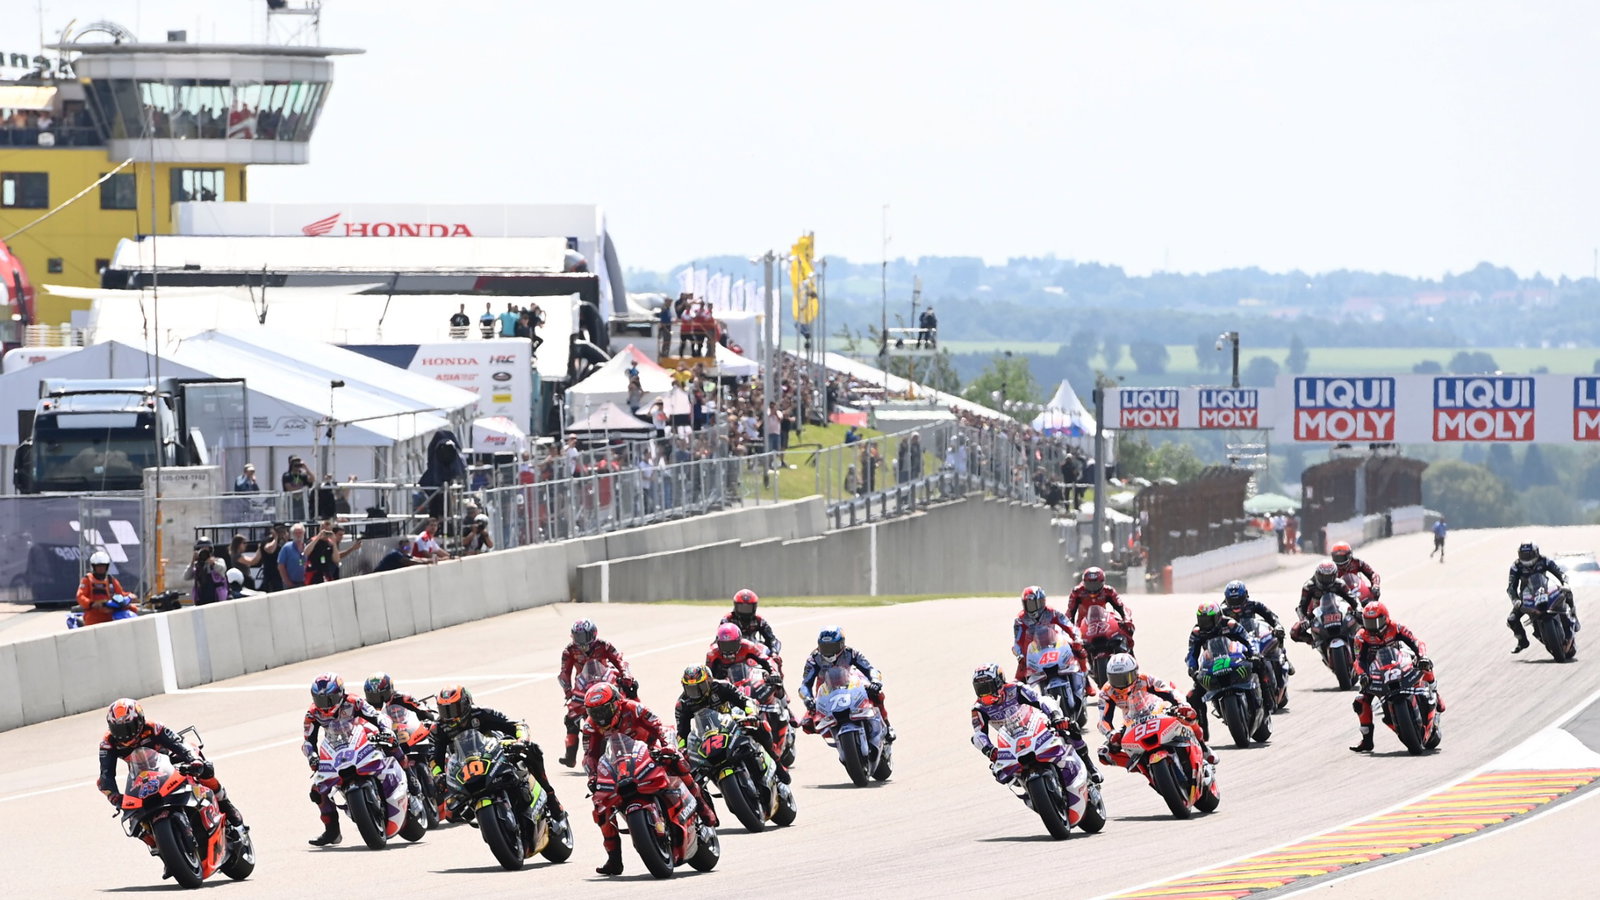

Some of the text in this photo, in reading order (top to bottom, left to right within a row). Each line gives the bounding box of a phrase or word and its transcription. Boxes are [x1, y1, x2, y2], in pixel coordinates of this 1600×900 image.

[343, 222, 473, 237] HONDA
[422, 358, 479, 366] HONDA
[489, 355, 516, 364] HRC
[1123, 391, 1177, 408] LIQUI
[1201, 391, 1257, 408] LIQUI
[1300, 380, 1391, 408] LIQUI
[1439, 380, 1531, 408] LIQUI
[1122, 410, 1178, 427] MOLY
[1201, 410, 1257, 427] MOLY
[1299, 411, 1392, 438] MOLY
[1438, 411, 1532, 438] MOLY
[1038, 651, 1059, 665] 49
[1211, 657, 1231, 672] 21
[1384, 668, 1401, 684] 12
[1134, 718, 1161, 742] 93
[702, 734, 724, 755] 72
[462, 760, 484, 782] 10
